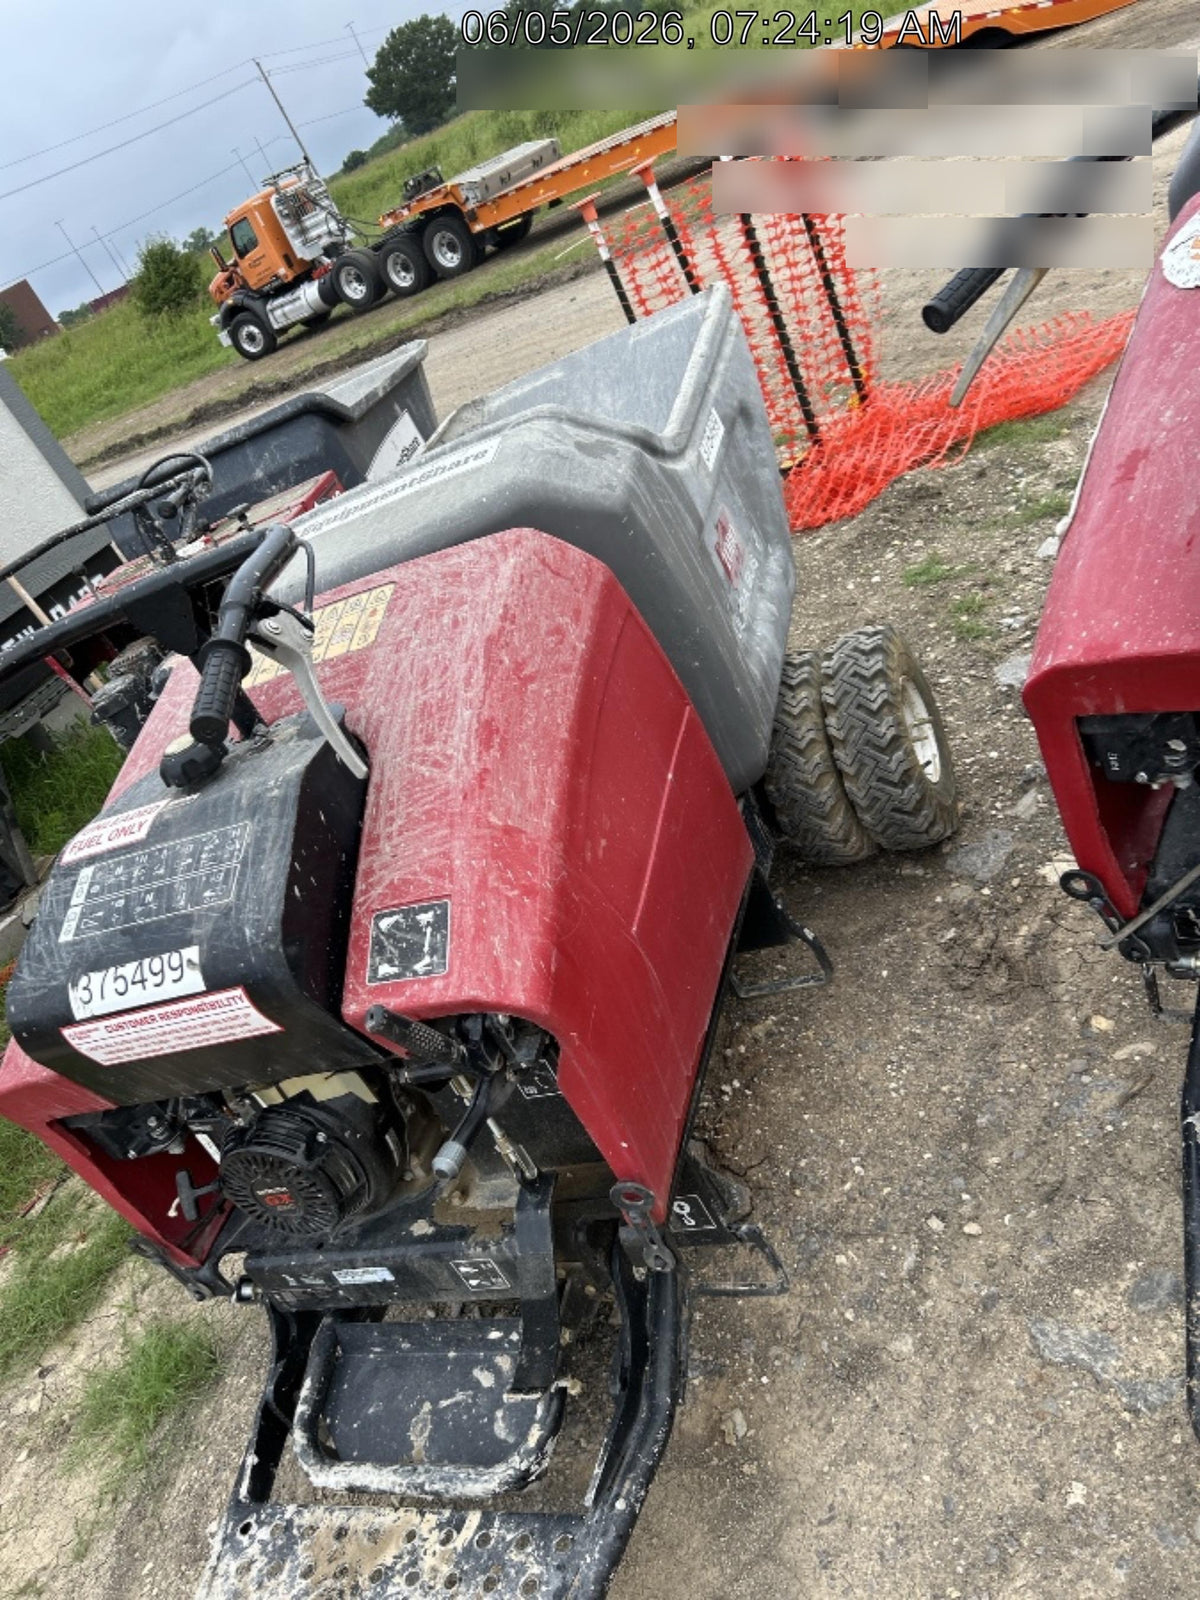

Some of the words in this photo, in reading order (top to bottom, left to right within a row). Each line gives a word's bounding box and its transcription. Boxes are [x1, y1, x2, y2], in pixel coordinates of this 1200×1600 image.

[68, 834, 103, 856] FUEL
[107, 819, 150, 843] ONLY
[103, 1014, 159, 1034] CUSTOMER
[158, 994, 246, 1022] RESPONSIBILITY
